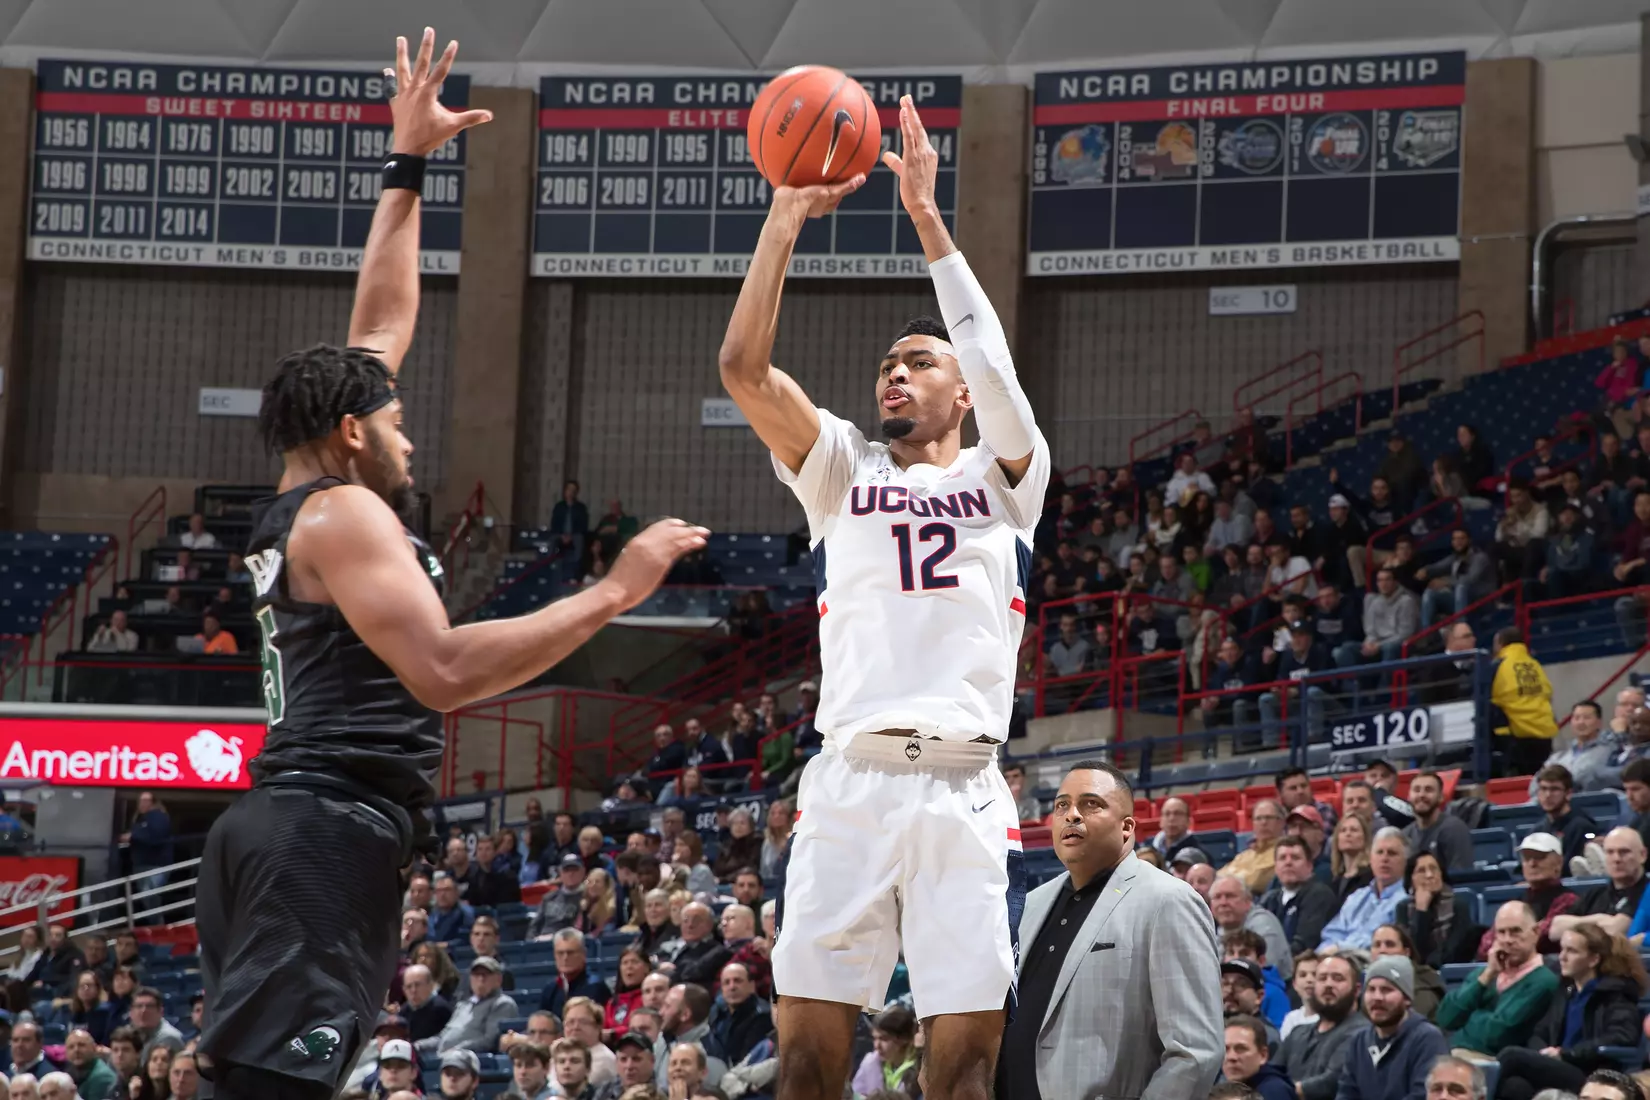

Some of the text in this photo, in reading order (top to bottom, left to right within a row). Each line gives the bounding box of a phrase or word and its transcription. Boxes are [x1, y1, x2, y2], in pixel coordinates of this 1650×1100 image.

[63, 66, 444, 99] NCAA CHAMPIONS
[565, 81, 936, 104] NCAA CHAMSHIP
[1059, 58, 1439, 99] NCAA CHAMPIONSHIP
[146, 97, 362, 121] SWEET SIXTEEN
[668, 109, 739, 127] ELITE
[1167, 93, 1325, 117] FINAL FOUR
[43, 118, 88, 147] 1956
[106, 120, 151, 150] 1964
[168, 122, 213, 153] 1976
[230, 125, 274, 154] 1990
[294, 127, 334, 156] 1991
[546, 135, 588, 163] 1964
[607, 135, 649, 163] 1990
[666, 135, 707, 162] 1995
[41, 161, 459, 203] 1996 1998 1999 2002 2003 200 006
[542, 177, 767, 205] 2006 2009 2011 2014
[36, 203, 208, 236] 2009 2011 2014
[40, 241, 448, 270] CONNECTICUT MEN'S BASKLL
[543, 258, 702, 274] CONNECTICUT
[793, 258, 928, 274] BASKETBAL
[1040, 241, 1445, 272] CONNECTICUT MEN'S BASKETBALL
[1212, 289, 1289, 308] SEC 10
[705, 406, 733, 420] SEC
[851, 485, 991, 518] UCONN
[891, 522, 960, 591] 12
[1332, 708, 1429, 746] SEC 120
[0, 740, 179, 780] Ameritas
